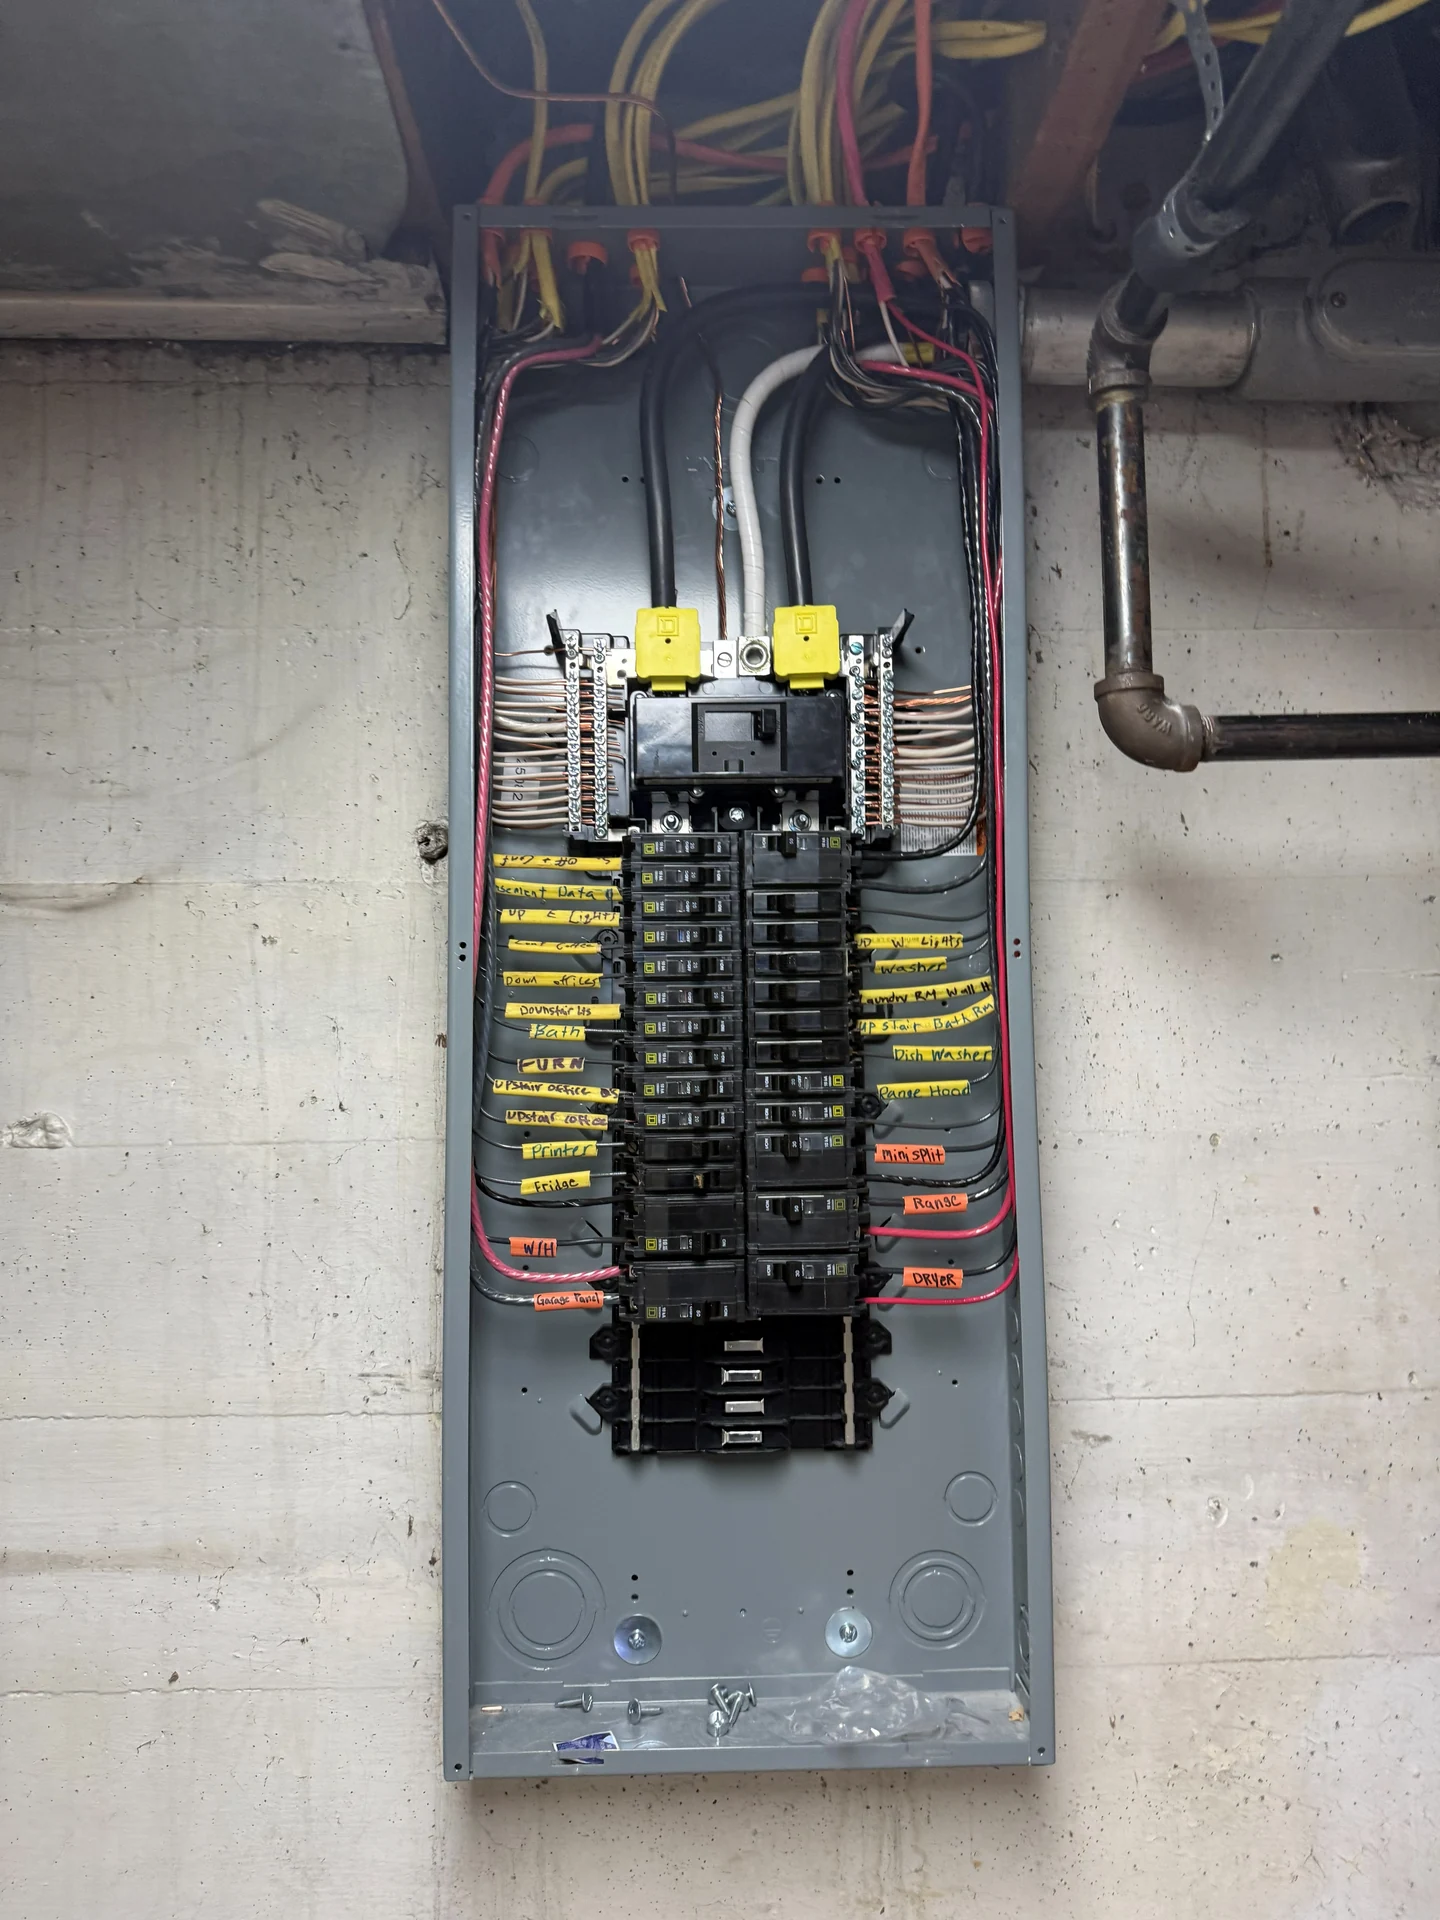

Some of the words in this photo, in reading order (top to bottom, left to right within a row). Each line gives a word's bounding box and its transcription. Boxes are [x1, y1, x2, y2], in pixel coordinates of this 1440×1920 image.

[933, 1013, 972, 1031] Bath
[534, 1024, 580, 1038] Bath
[894, 1048, 923, 1061] Dish
[929, 1085, 970, 1097] Hood
[532, 1143, 593, 1157] Printer
[534, 1178, 579, 1193] Fridge
[524, 1240, 554, 1257] W/H
